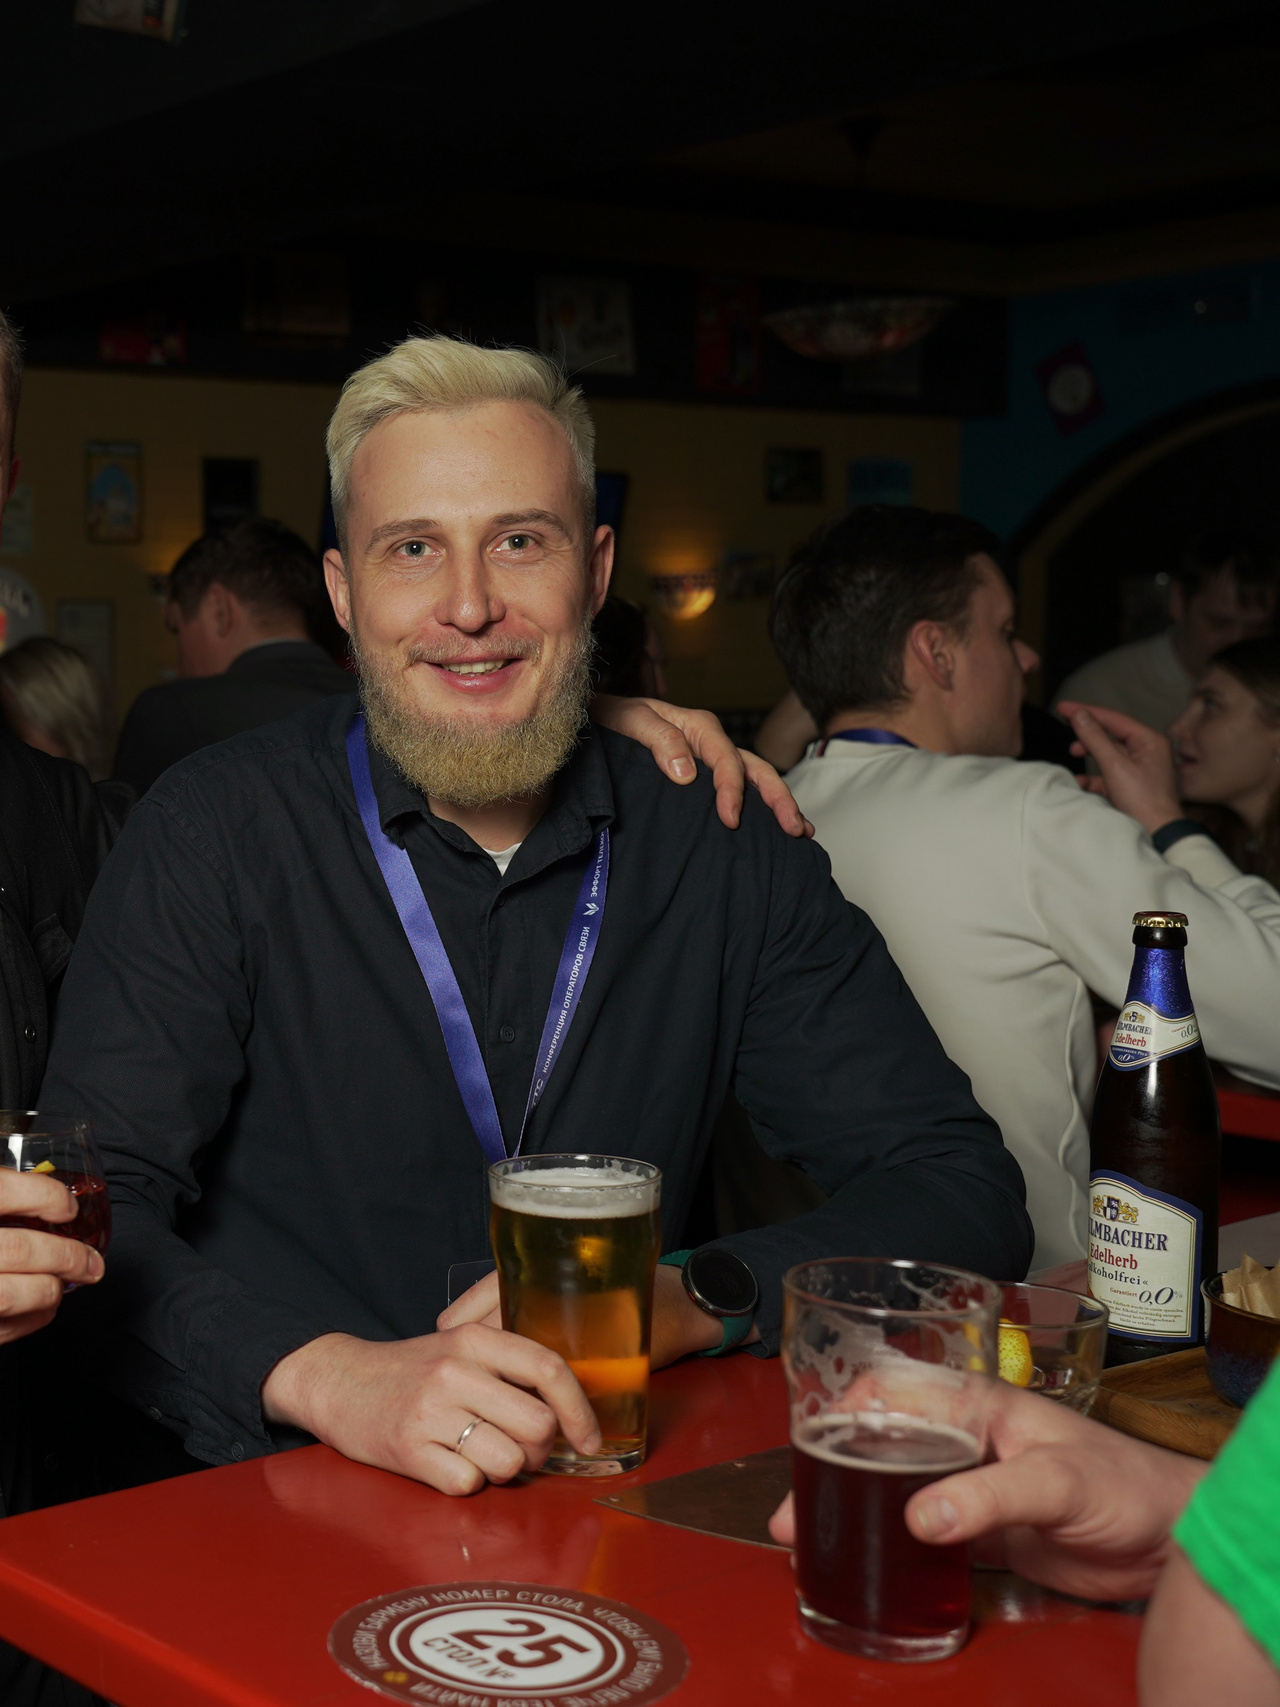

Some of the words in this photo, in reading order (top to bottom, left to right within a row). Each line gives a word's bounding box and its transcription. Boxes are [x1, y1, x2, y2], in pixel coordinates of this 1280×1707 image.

[591, 865, 602, 897] ЭФФОРТ
[542, 1010, 568, 1074] КОНФЕРЕНЦИЯ
[563, 953, 584, 1009] ОПЕРАТОРОВ
[578, 926, 591, 953] СВЯЗИ
[1115, 1032, 1147, 1047] Edelherb
[1087, 1217, 1168, 1251] LMBACHER
[1090, 1243, 1138, 1270] Edelherb
[359, 1595, 430, 1631] БАРМЕНУ
[431, 1589, 510, 1604] НОМЕР
[593, 1606, 651, 1640] ЧТОБЫ
[422, 1636, 491, 1669] СТОЛ
[447, 1618, 594, 1668] 25
